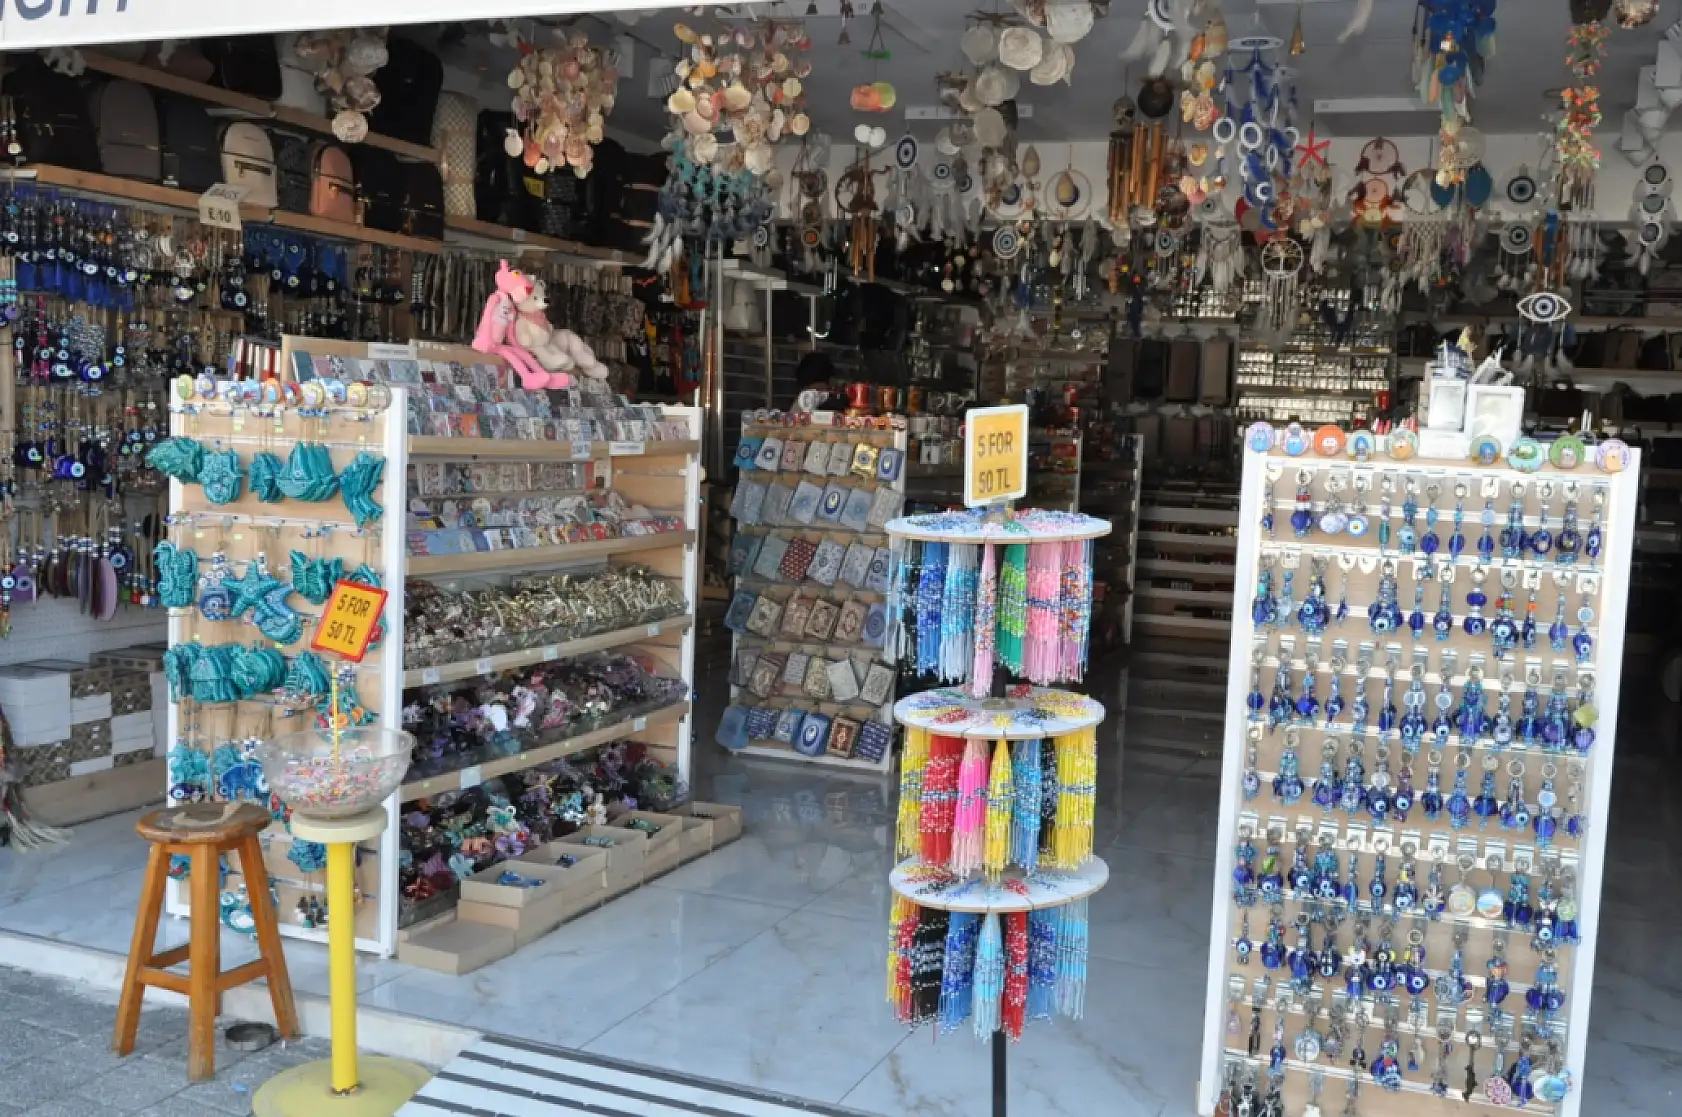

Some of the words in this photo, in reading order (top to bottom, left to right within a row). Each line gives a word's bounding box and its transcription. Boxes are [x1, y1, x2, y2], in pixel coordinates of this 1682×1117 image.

[978, 434, 986, 457] 5
[988, 430, 1014, 456] FOR
[979, 469, 993, 493] 50
[996, 467, 1011, 490] TL
[336, 593, 348, 611] 5
[346, 596, 371, 618] FOR
[326, 620, 344, 640] 50
[343, 624, 356, 645] TL
